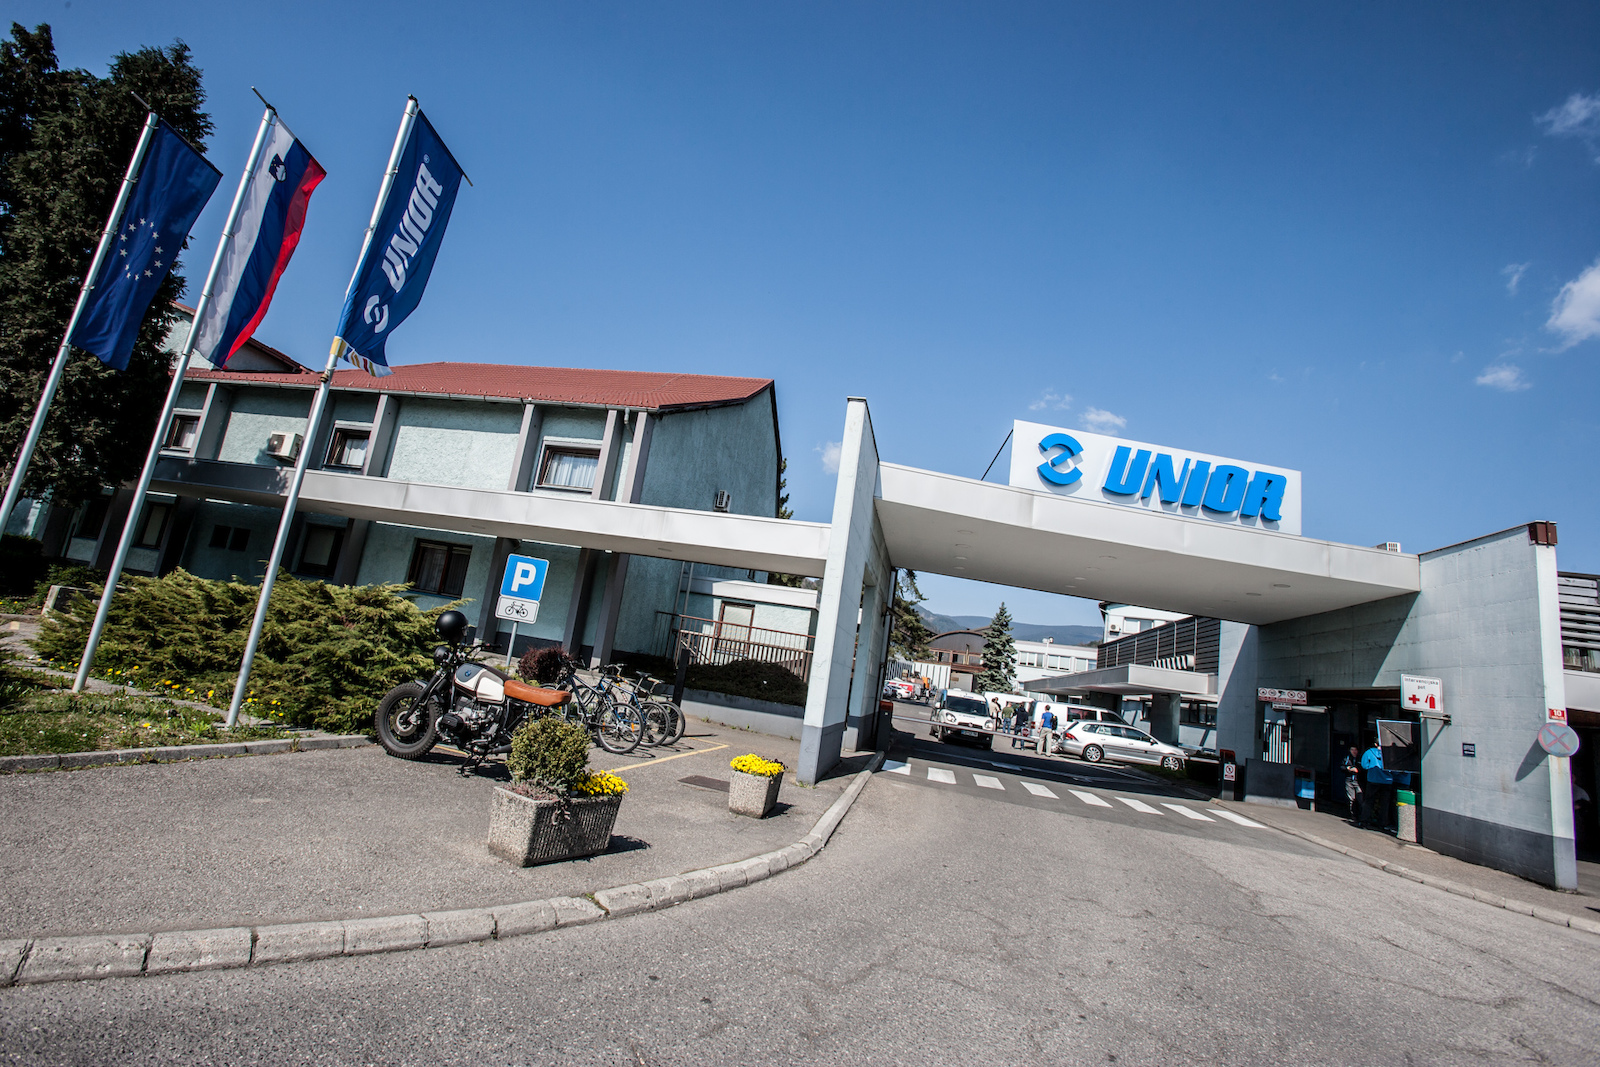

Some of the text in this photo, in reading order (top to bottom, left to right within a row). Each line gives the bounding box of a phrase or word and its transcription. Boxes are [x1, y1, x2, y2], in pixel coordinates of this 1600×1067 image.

[382, 163, 443, 293] UNIOR
[1101, 445, 1287, 521] UNIOR
[511, 561, 537, 592] P
[1553, 709, 1562, 717] 10
